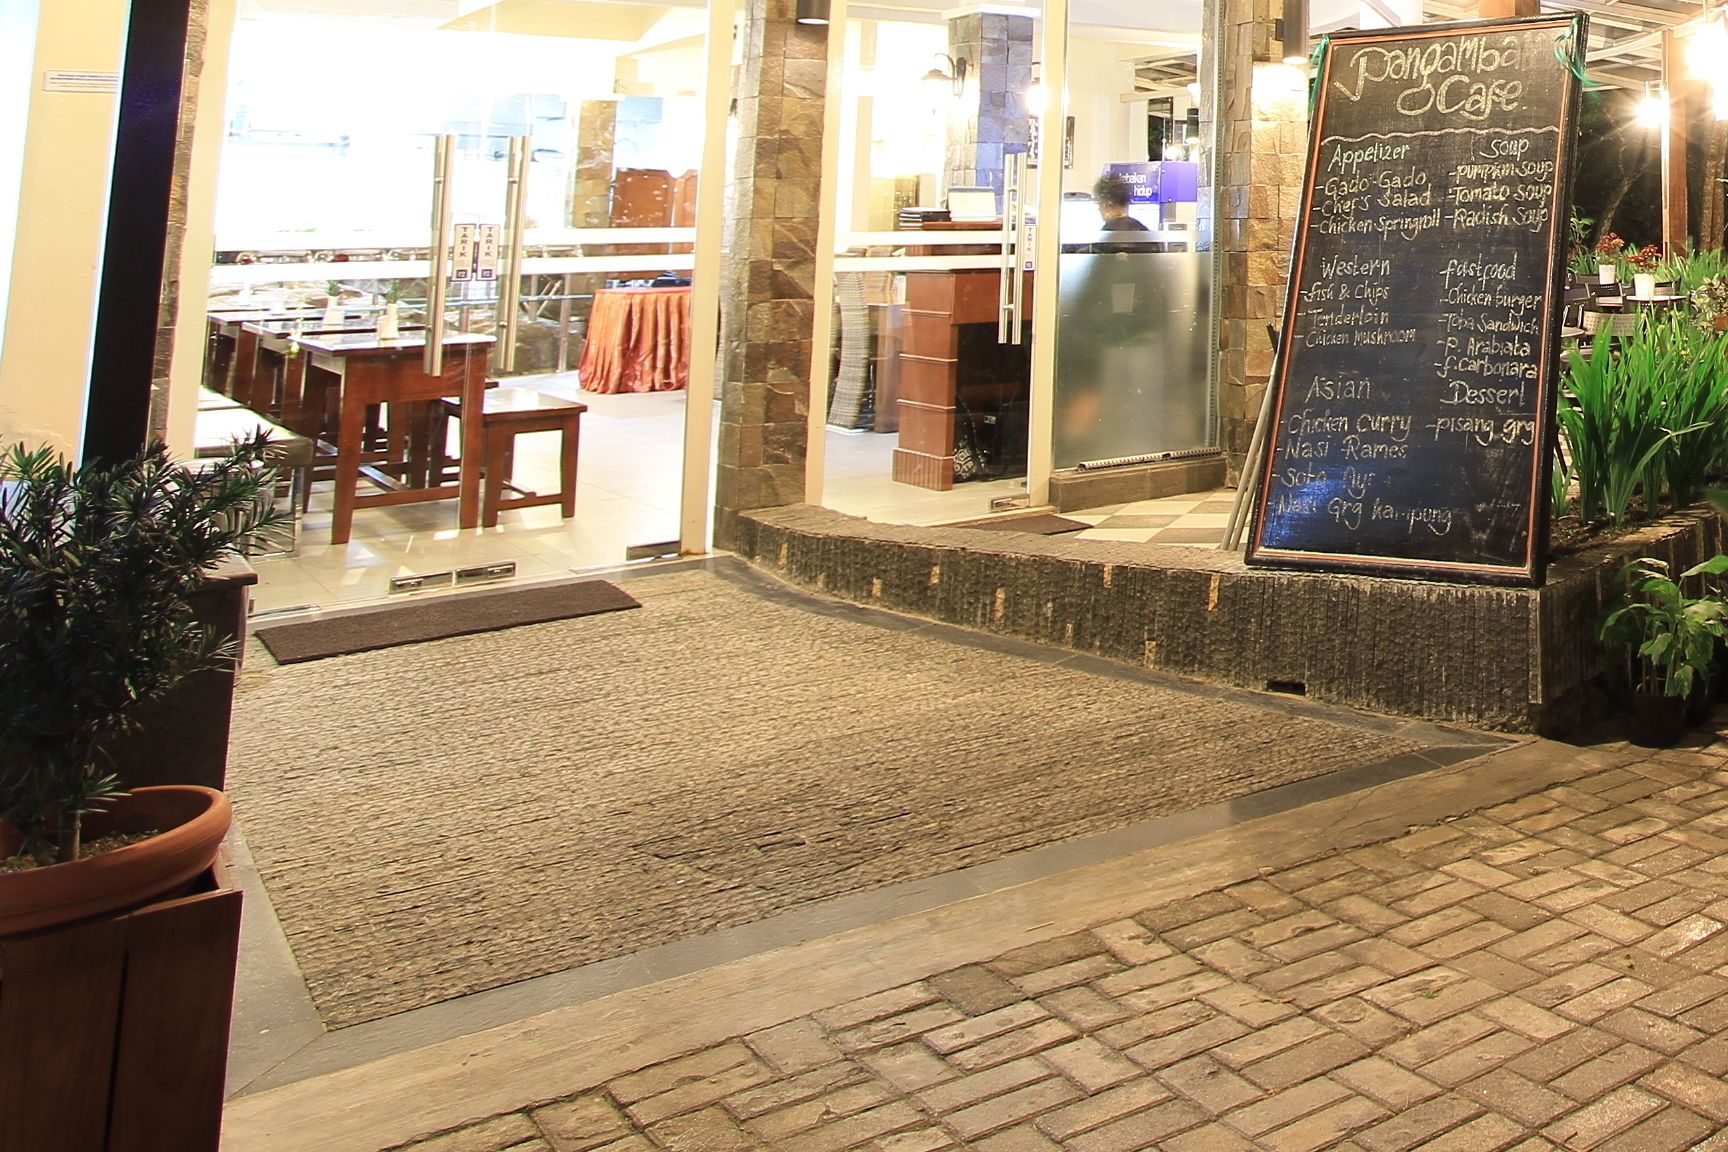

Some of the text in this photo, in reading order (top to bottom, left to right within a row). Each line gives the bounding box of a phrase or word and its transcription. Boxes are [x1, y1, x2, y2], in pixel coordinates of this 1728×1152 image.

[1436, 74, 1522, 120] Cafe
[1326, 143, 1410, 174] Appetizer
[1133, 185, 1152, 198] hidup
[1453, 182, 1510, 206] Tomato
[1453, 204, 1509, 229] Radish
[460, 227, 470, 257] TARIK
[484, 227, 494, 257] TARIK
[1320, 254, 1391, 279] Western
[1338, 284, 1350, 300] &
[1448, 283, 1492, 306] Chicken
[1308, 304, 1389, 328] Tenderloin
[1442, 308, 1474, 332] Toba
[1467, 334, 1531, 357] Arabiata
[1305, 375, 1371, 404] Asian
[1440, 380, 1525, 406] Dessert
[1285, 434, 1408, 460] Nasi Rames
